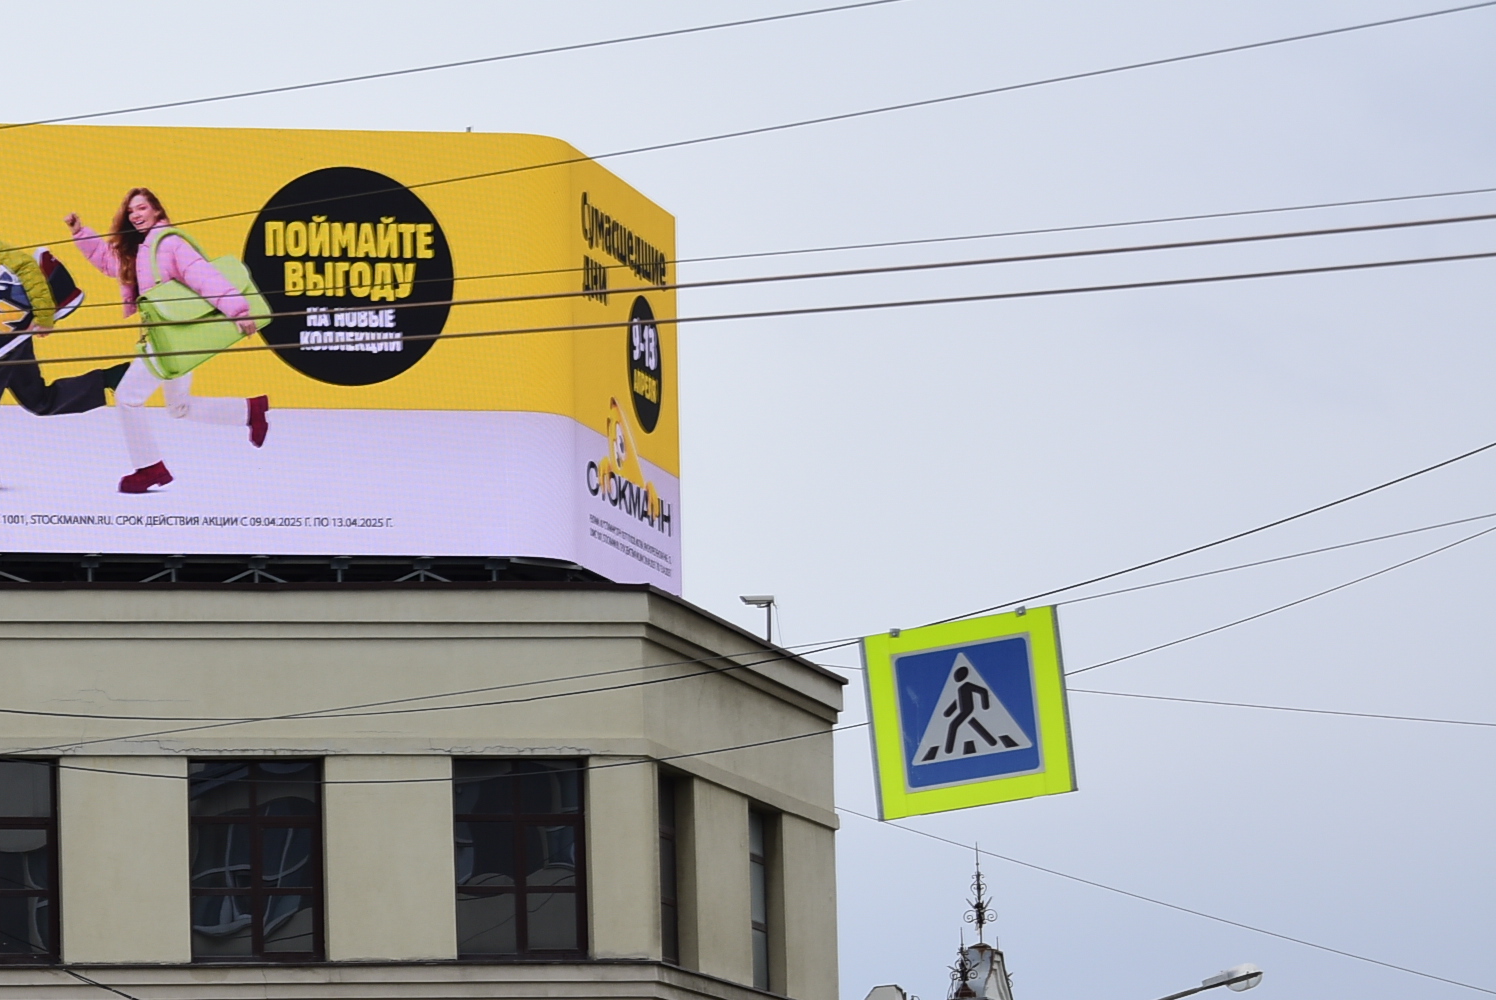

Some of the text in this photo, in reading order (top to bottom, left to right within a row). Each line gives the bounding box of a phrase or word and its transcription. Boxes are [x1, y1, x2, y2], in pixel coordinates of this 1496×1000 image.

[265, 215, 435, 259] ПОЙМАЙТЕ
[284, 261, 416, 301] ВЫГОДУ
[306, 307, 396, 328] НА НОВЫЕ
[300, 331, 403, 353] КОЛЛЕКЦИИ
[2, 514, 29, 526] 1001,
[30, 514, 114, 526] STOCKMANN.RU.
[115, 515, 144, 526] СРОК
[145, 514, 200, 527] ДЕЙСТВИЯ
[202, 516, 238, 528] АКЦИИ
[240, 516, 248, 527] С
[249, 516, 302, 527] 09.04.2025
[313, 517, 329, 527] ПО
[331, 517, 384, 528] 13.04.2025
